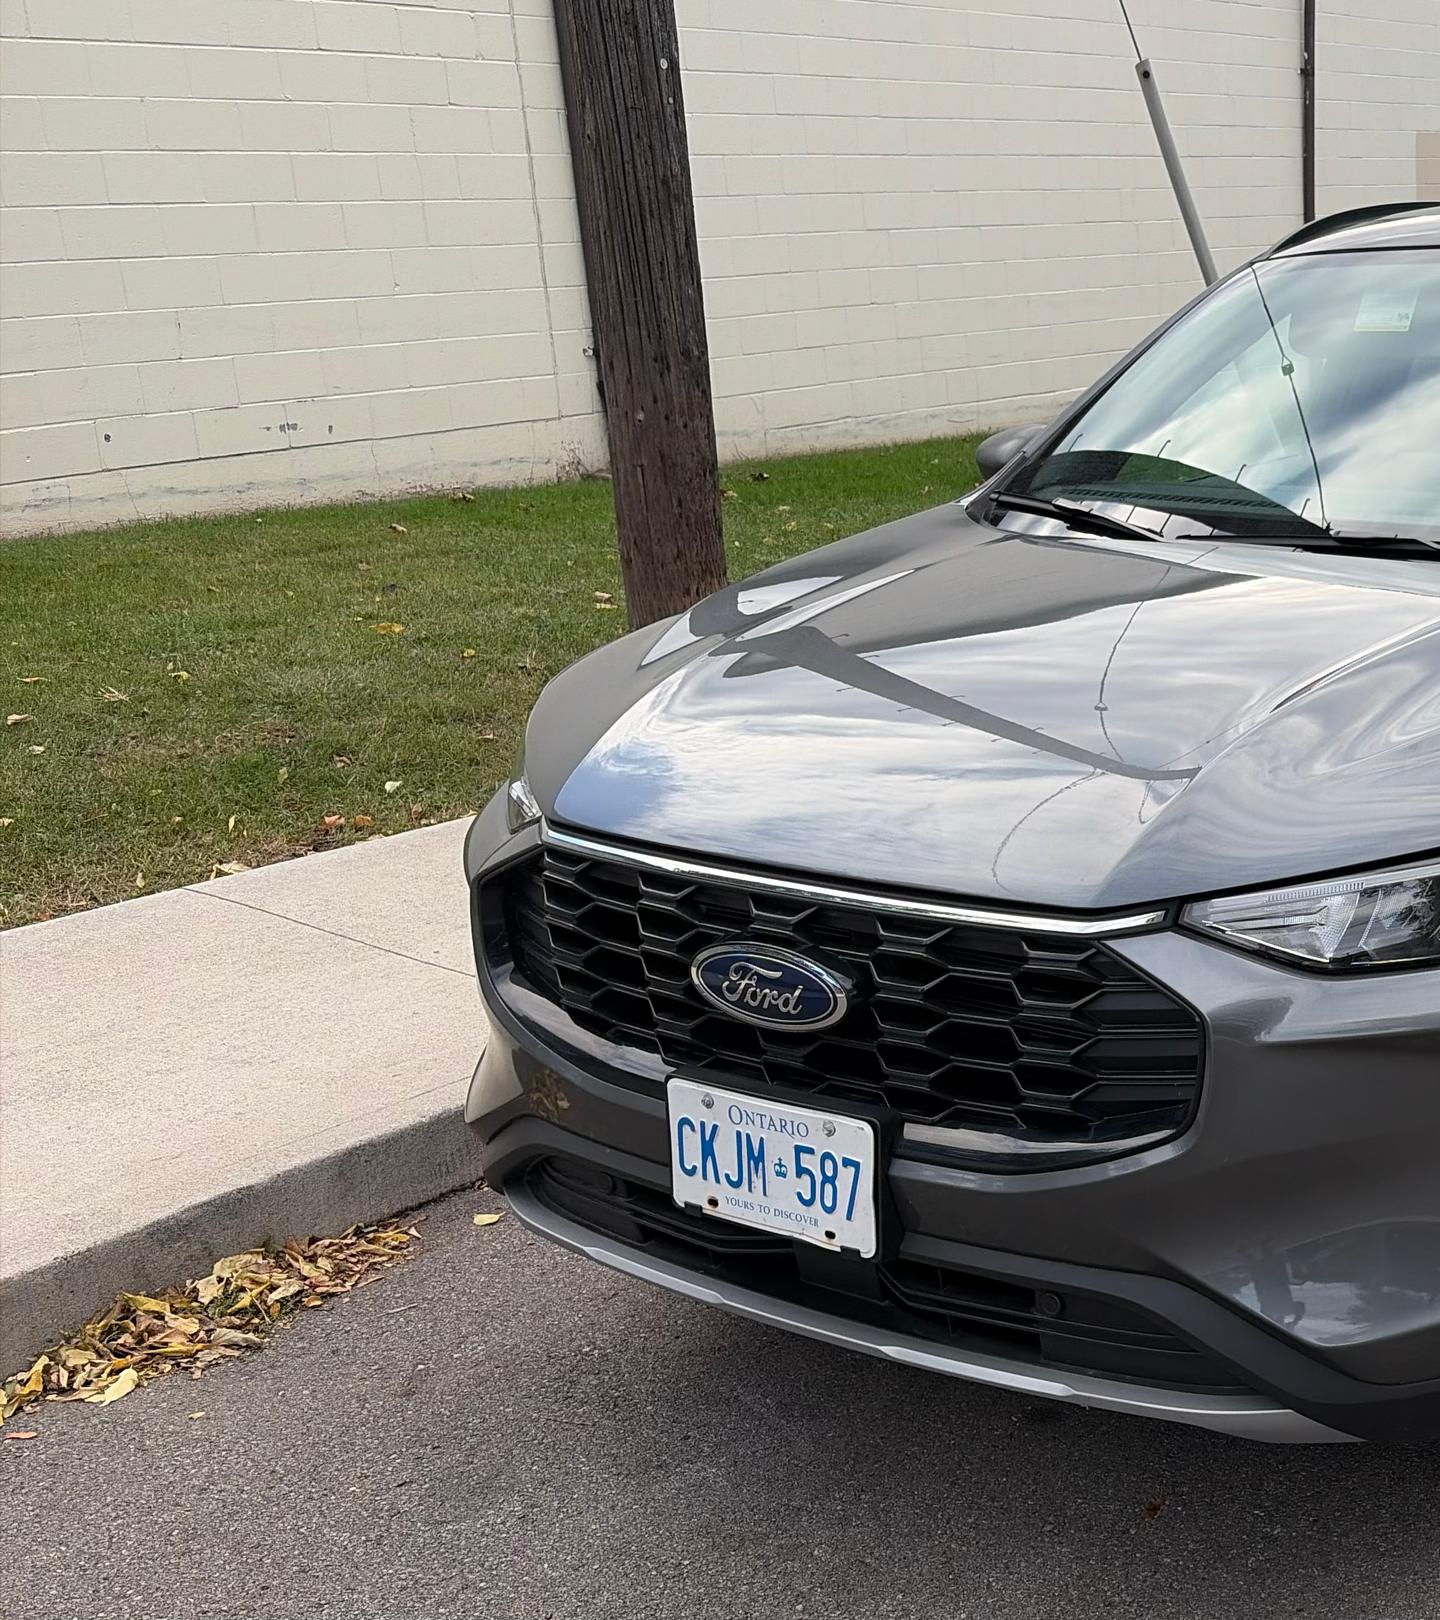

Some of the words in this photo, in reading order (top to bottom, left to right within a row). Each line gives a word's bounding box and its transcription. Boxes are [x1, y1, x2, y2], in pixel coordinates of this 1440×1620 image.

[721, 961, 804, 1015] Ford
[677, 1116, 768, 1197] CKJM
[793, 1143, 861, 1222] 587
[725, 1195, 755, 1212] YOURS
[757, 1203, 771, 1215] TO
[773, 1208, 819, 1228] DISCOVER
